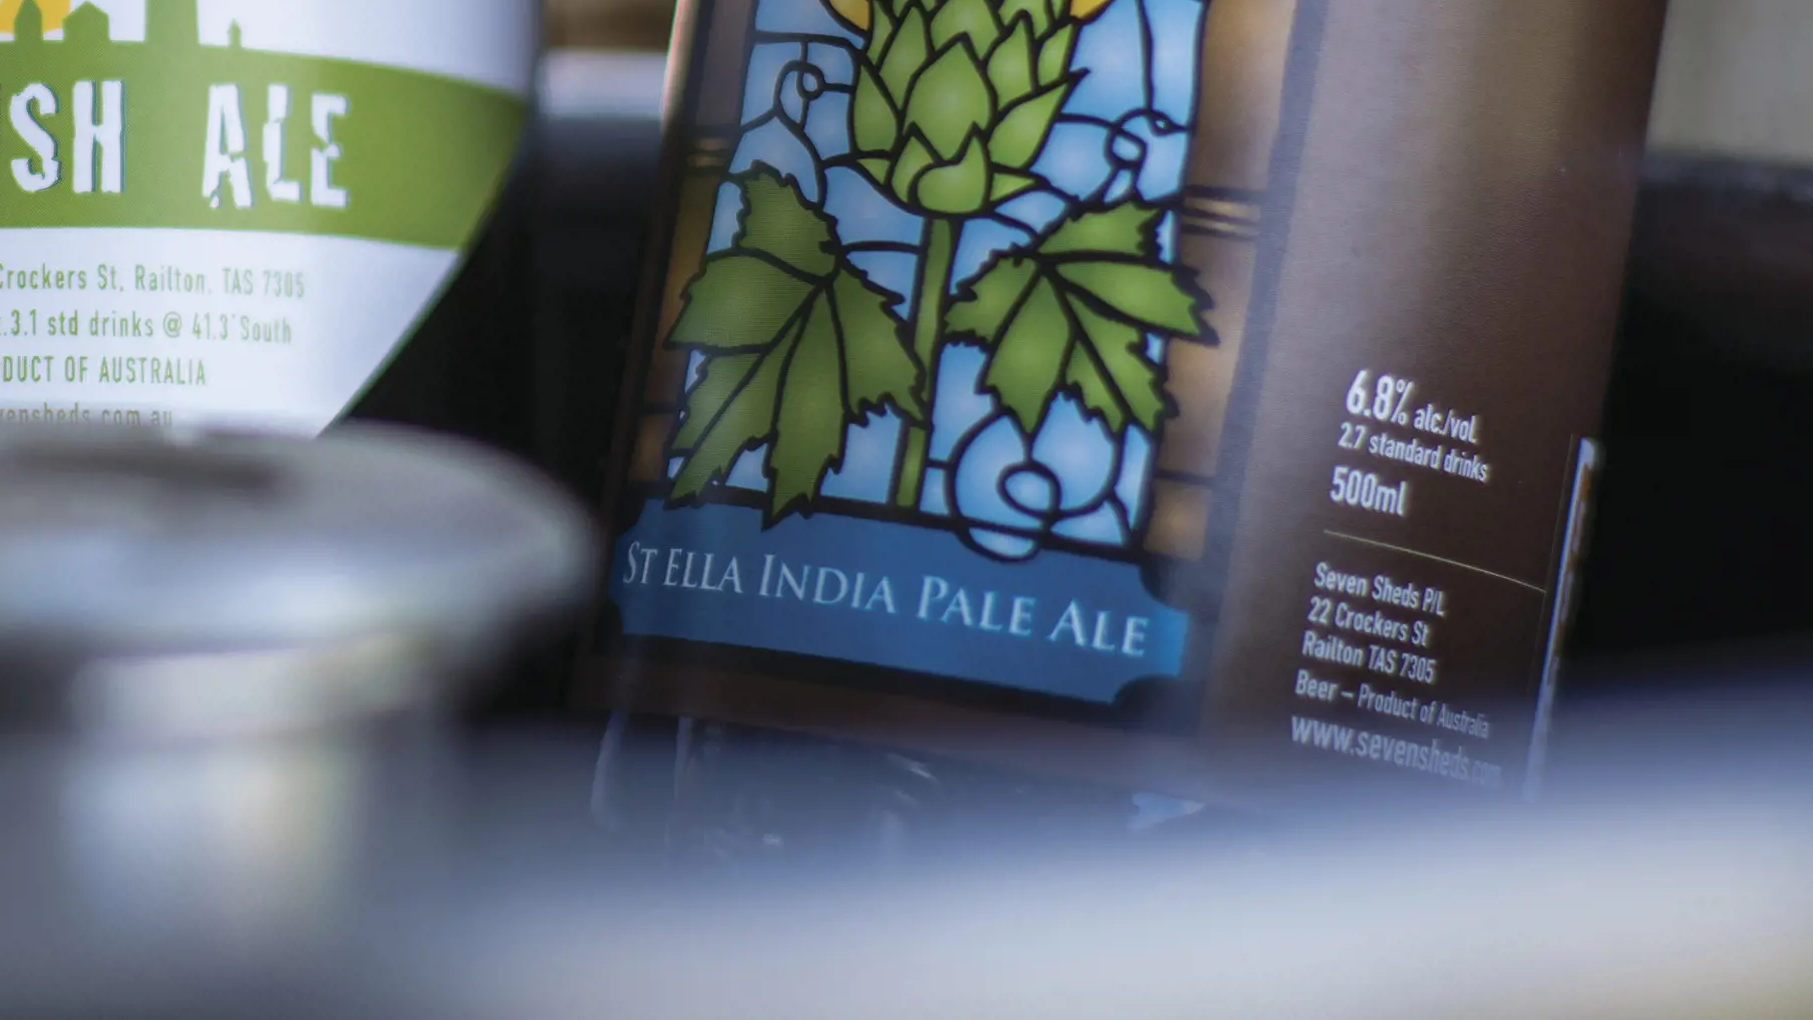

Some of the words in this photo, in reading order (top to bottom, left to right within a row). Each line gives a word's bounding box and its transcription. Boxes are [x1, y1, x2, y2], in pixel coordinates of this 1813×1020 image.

[201, 83, 350, 210] ALE
[222, 267, 255, 296] TAS
[262, 269, 306, 300] 7305
[47, 308, 79, 336] std
[89, 309, 155, 338] drinks
[162, 311, 183, 339] @
[64, 355, 89, 383] OF
[98, 356, 207, 386] AUSTRALIA
[1346, 369, 1415, 426] 6.8%
[1337, 421, 1367, 450] 2.7
[1368, 432, 1443, 470] standard
[1443, 448, 1490, 484] drinks
[1329, 465, 1408, 517] 500ml
[758, 553, 897, 615] INDIA
[915, 574, 1037, 637] PALE
[1046, 597, 1150, 657] ALE
[1313, 560, 1368, 597] Seven
[1371, 574, 1420, 609] Sheds
[1306, 595, 1333, 625] 22
[1334, 601, 1409, 642] Crockers
[1411, 619, 1431, 648] St
[1301, 629, 1364, 668] Railton
[1368, 643, 1397, 674] TAS
[1399, 652, 1437, 685] 7305
[1294, 668, 1338, 702] Beer
[1357, 682, 1418, 721] Product
[1419, 701, 1436, 725] of
[1436, 703, 1490, 739] Australia
